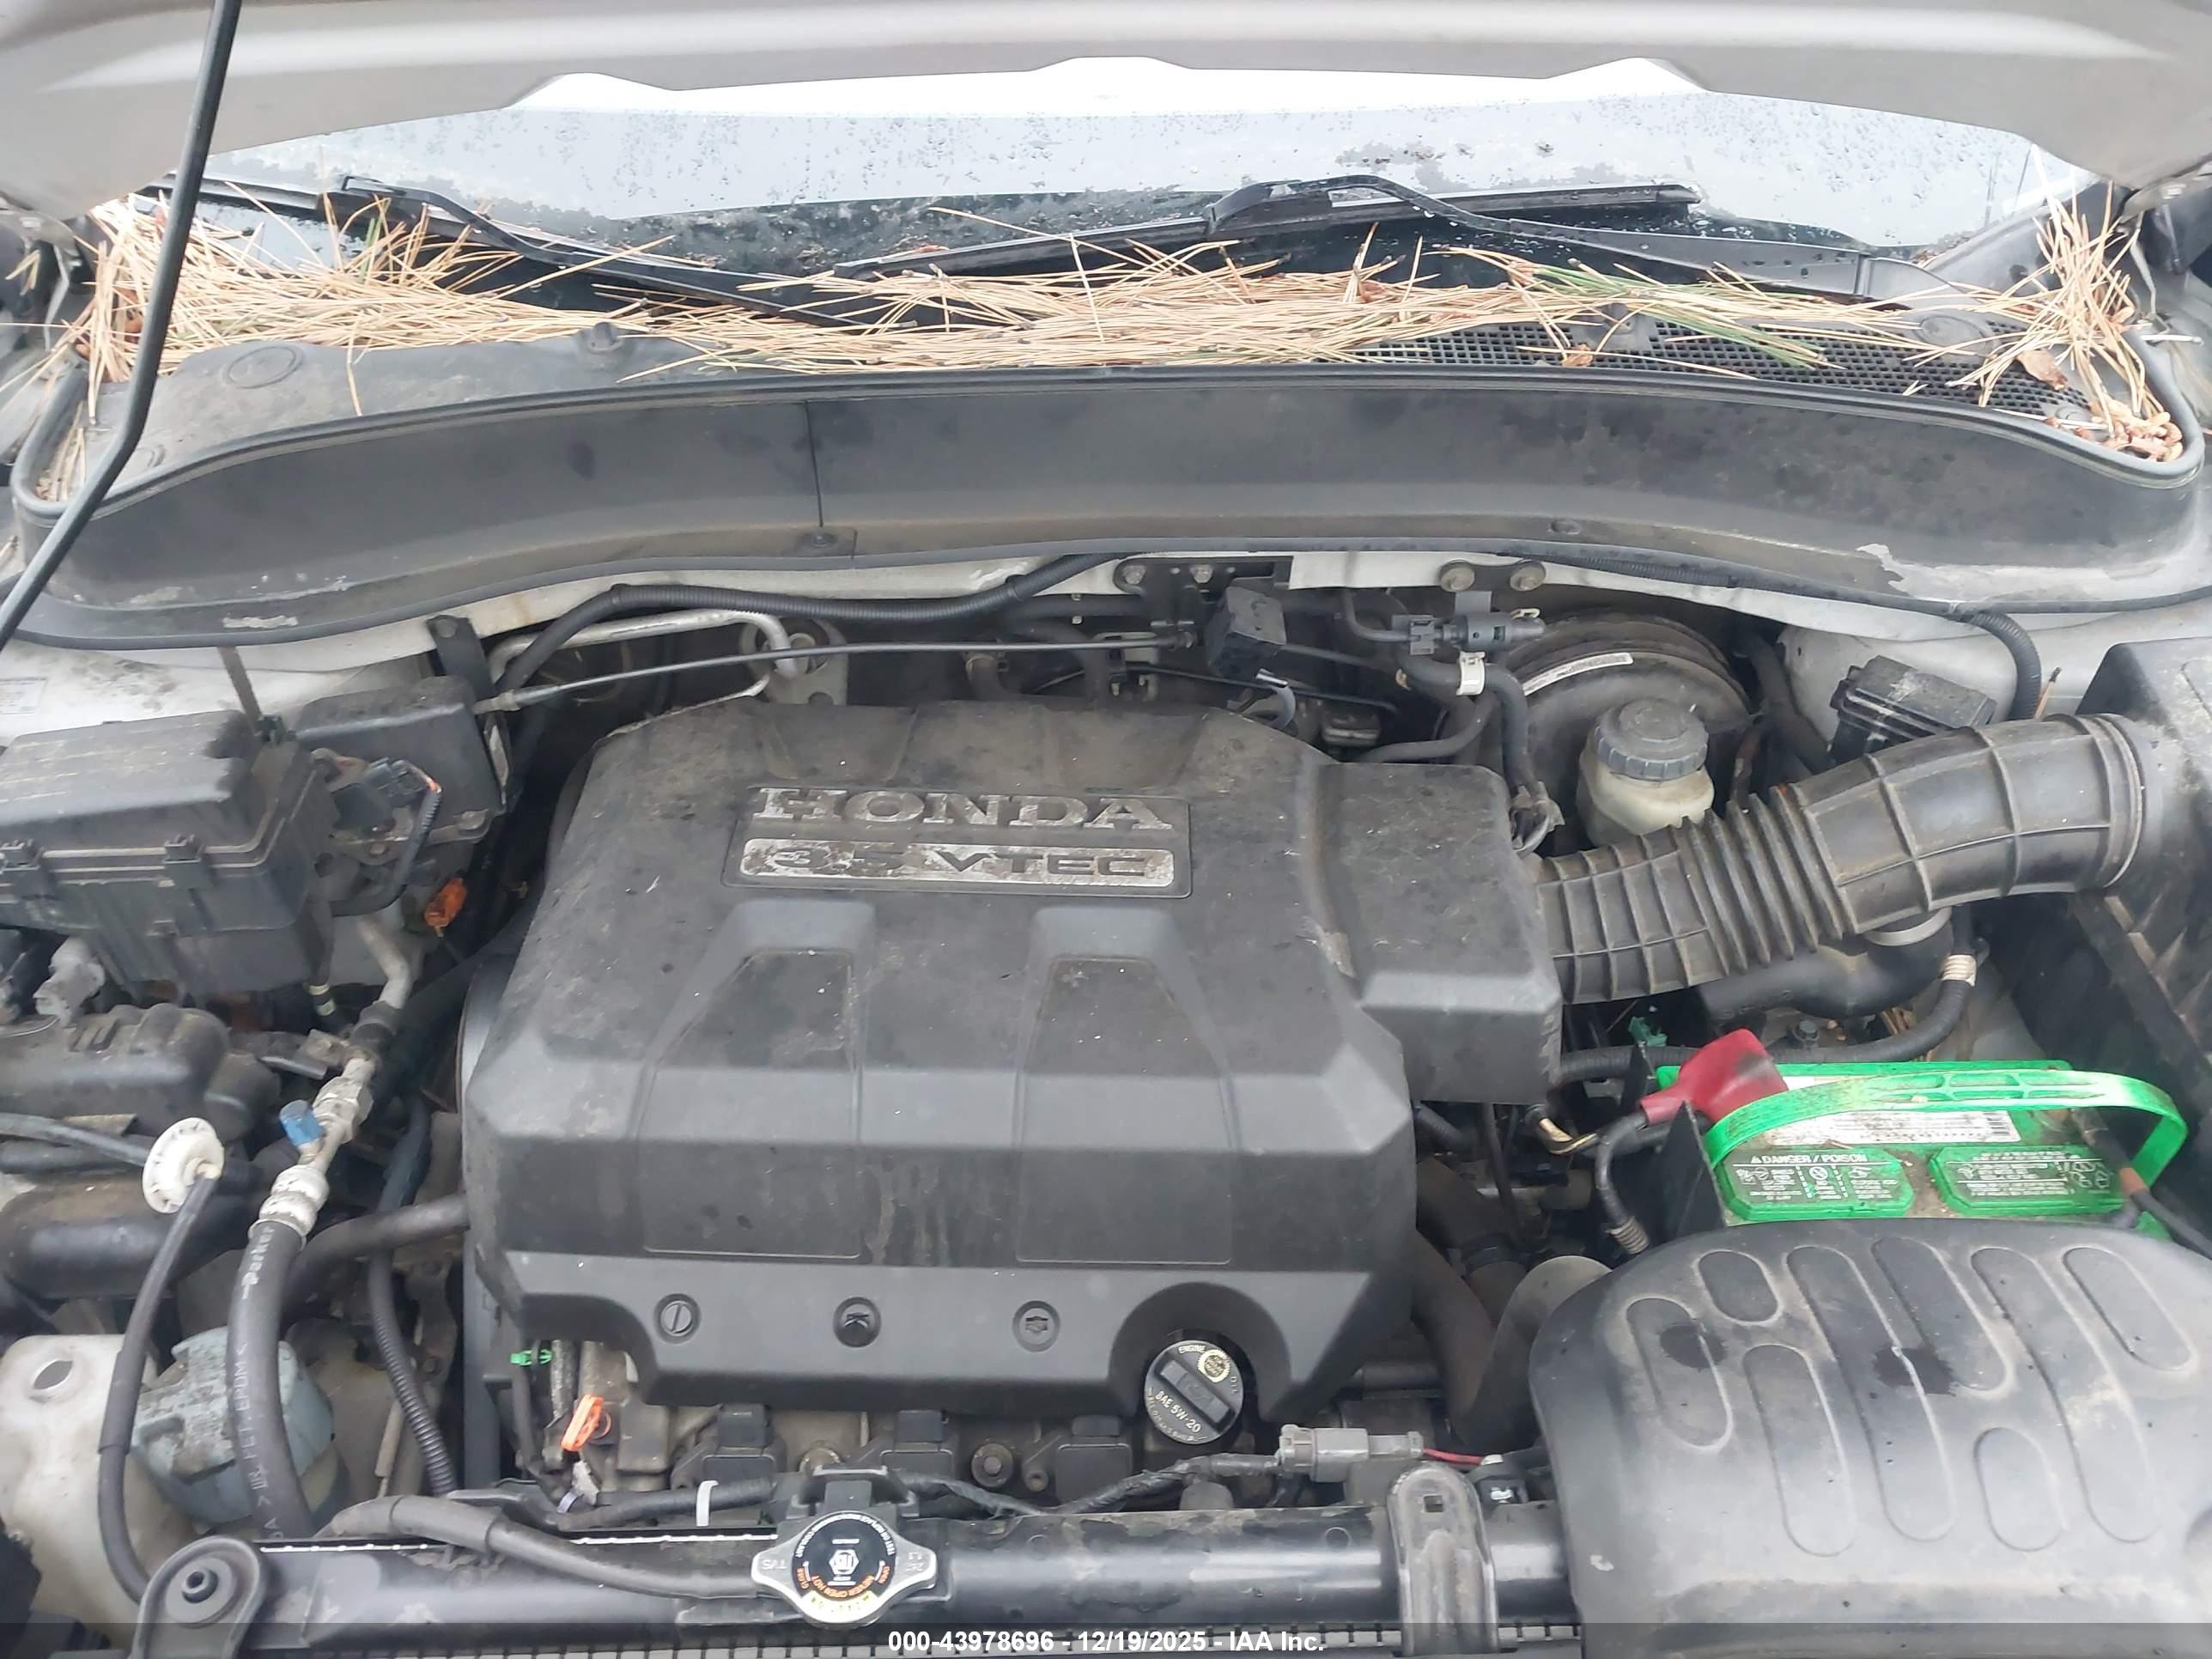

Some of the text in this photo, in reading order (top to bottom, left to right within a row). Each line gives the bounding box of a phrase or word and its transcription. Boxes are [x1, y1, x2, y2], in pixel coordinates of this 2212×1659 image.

[753, 787, 1173, 830] HONDA
[932, 849, 1146, 877] VTEC
[1762, 1154, 1812, 1164] DANGER
[1821, 1153, 1868, 1163] POISON
[240, 1225, 275, 1286] Parker
[1170, 1404, 1202, 1434] 5W-20
[810, 1575, 826, 1591] HOT
[823, 1587, 848, 1599] OPEN
